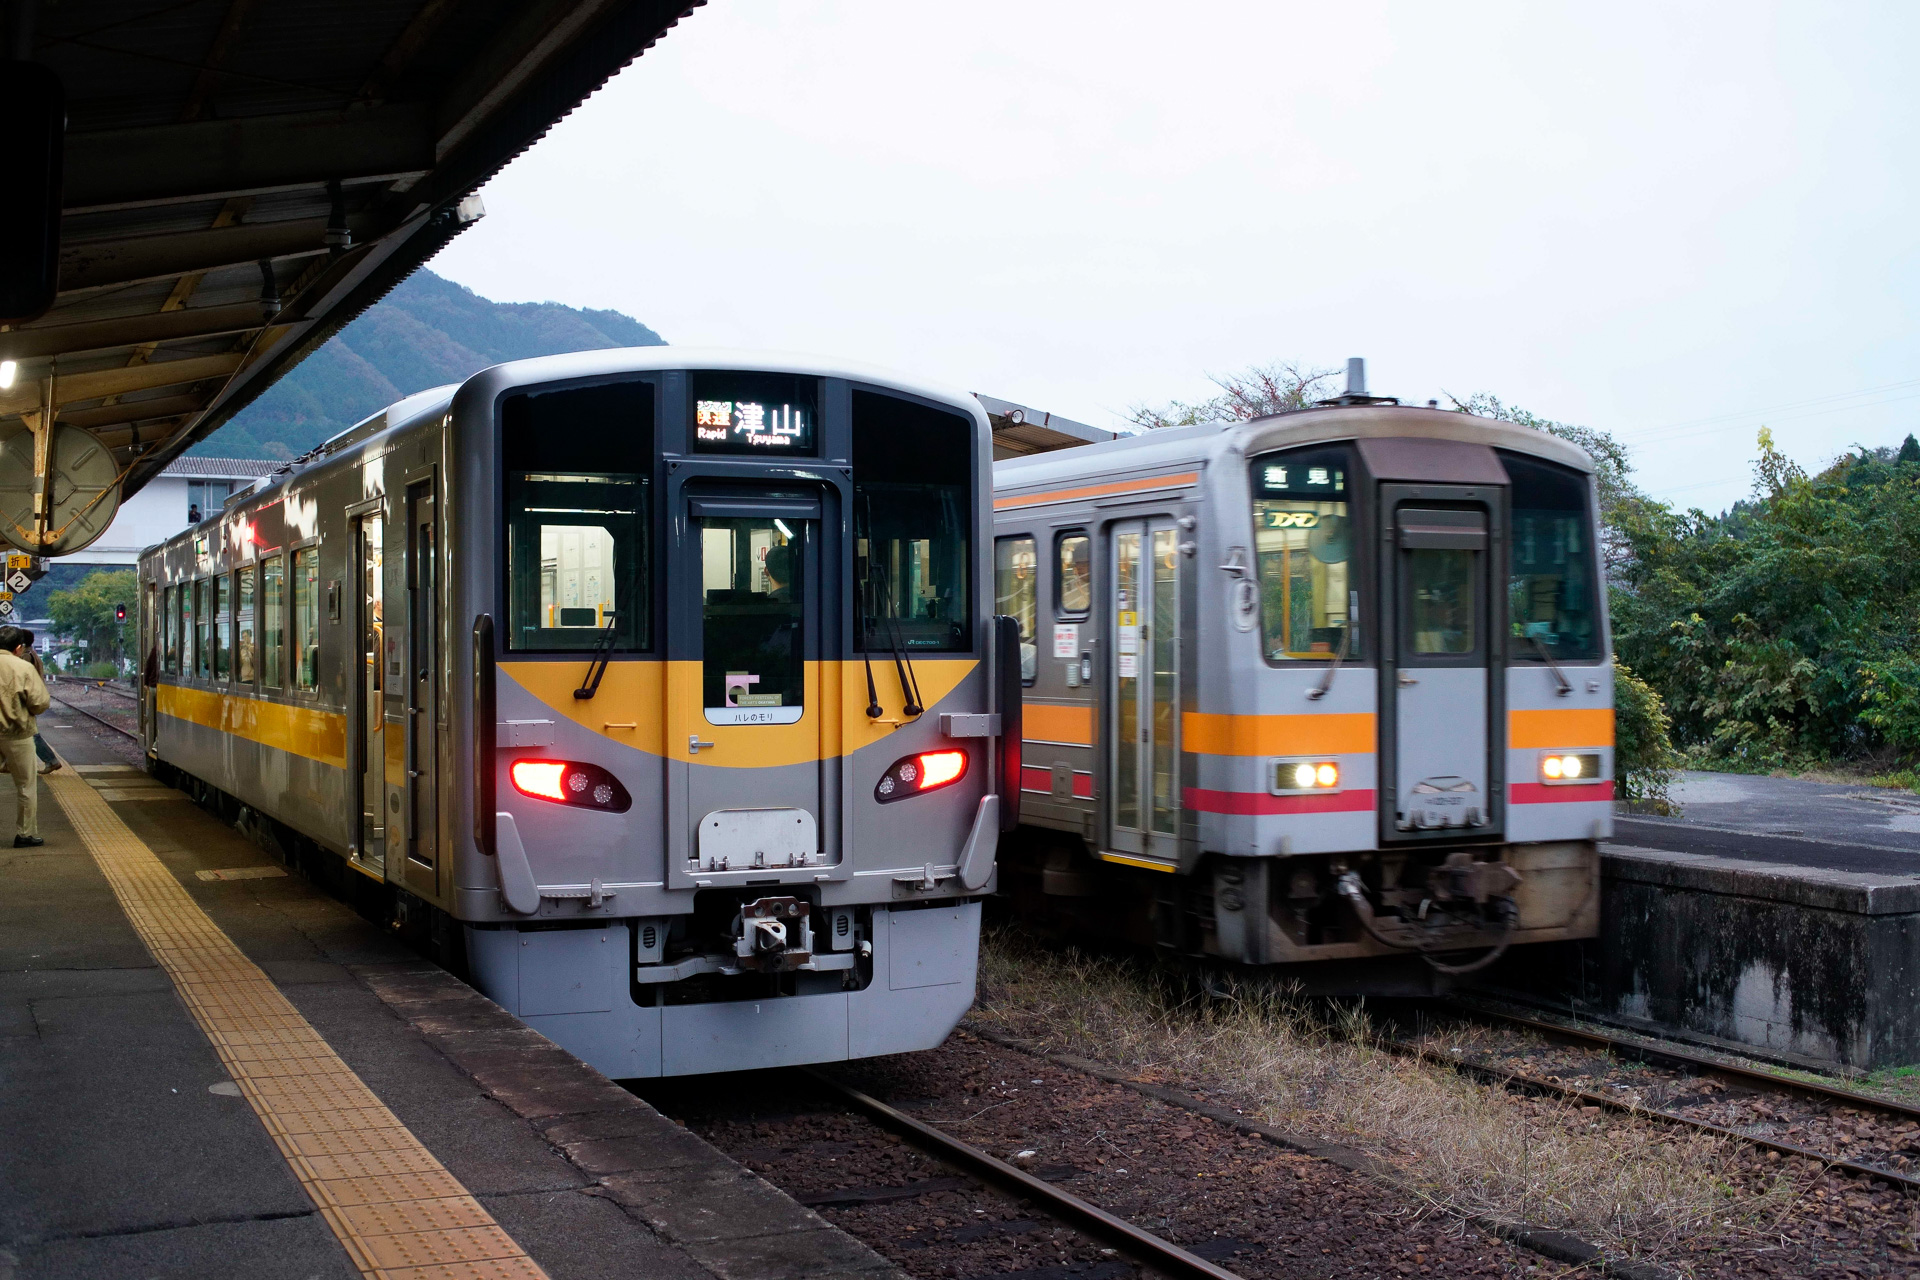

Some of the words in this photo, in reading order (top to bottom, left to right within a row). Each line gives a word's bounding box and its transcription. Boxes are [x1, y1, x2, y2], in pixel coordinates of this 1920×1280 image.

[697, 411, 731, 425] 快速
[734, 401, 800, 436] 津山
[697, 428, 727, 440] Rapid
[746, 433, 791, 445] Tsuyama
[14, 575, 24, 588] 2
[2, 603, 9, 612] 3
[734, 713, 773, 722] ハレのモリ
[754, 1004, 760, 1014] 1
